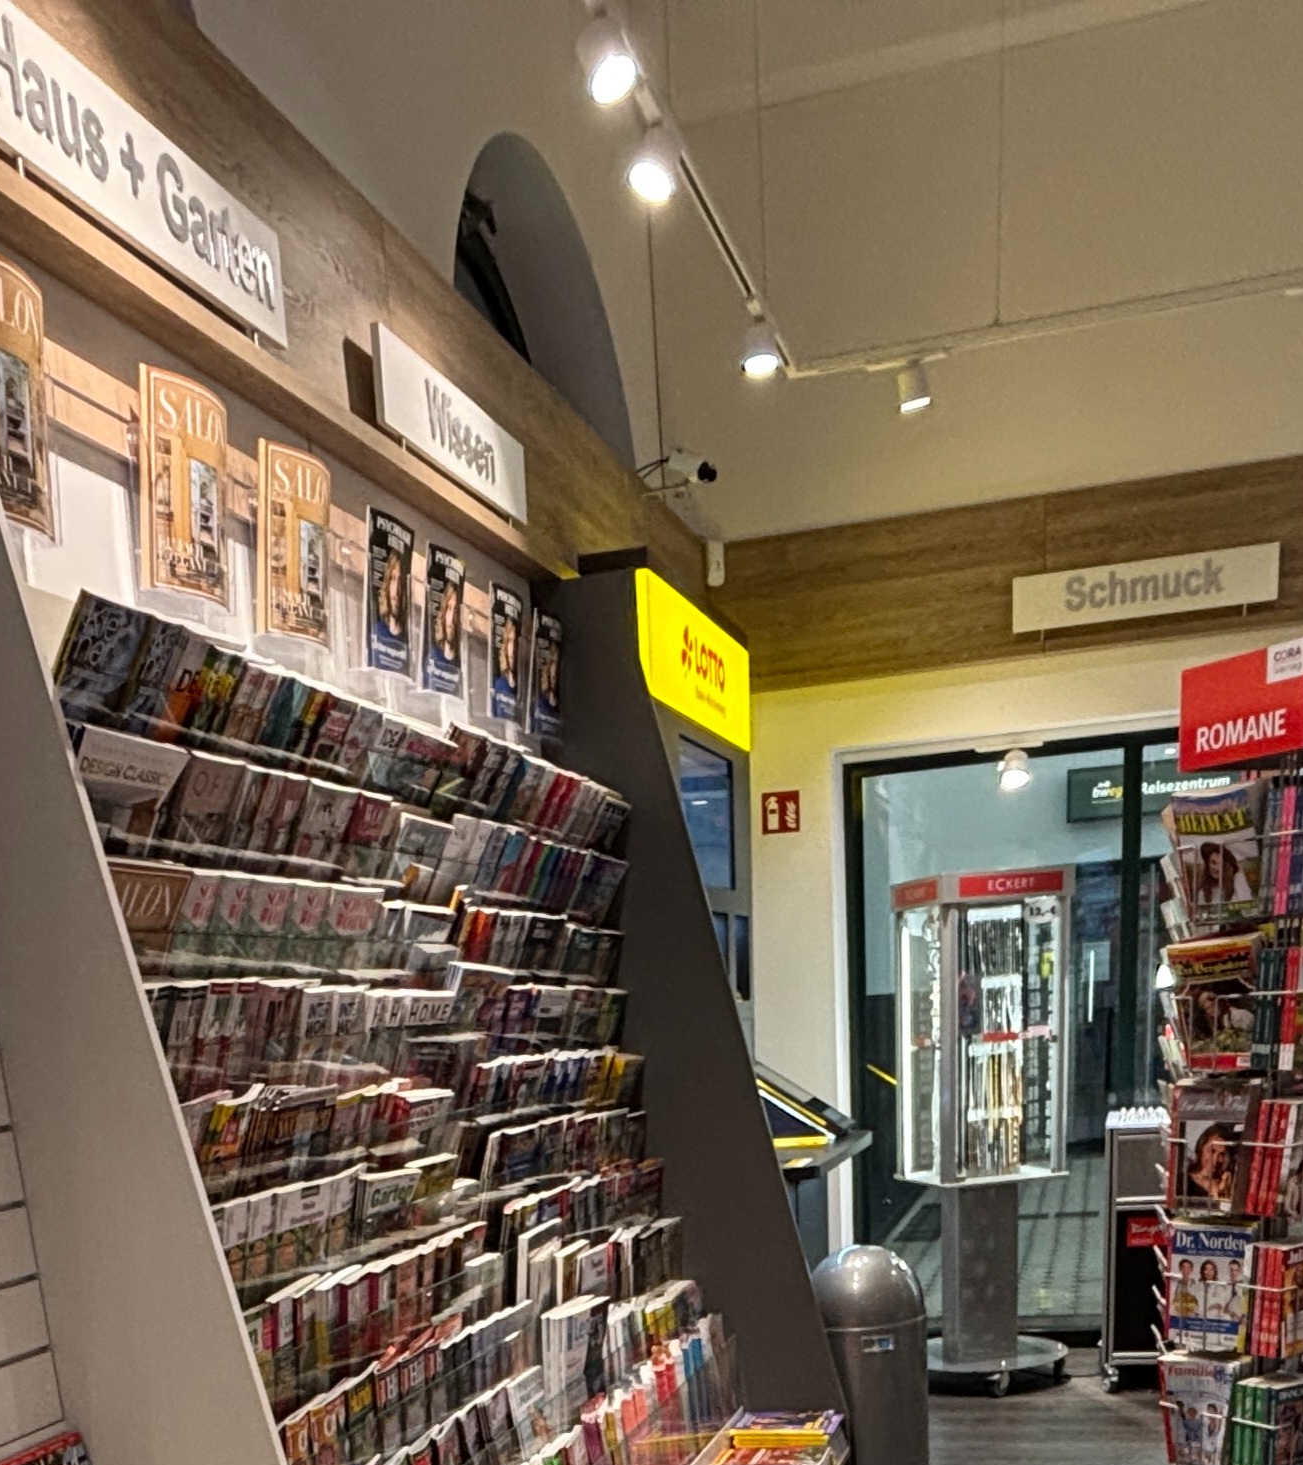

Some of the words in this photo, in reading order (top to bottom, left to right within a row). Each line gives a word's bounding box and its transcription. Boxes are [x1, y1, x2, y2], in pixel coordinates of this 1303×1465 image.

[155, 151, 277, 313] Garten
[423, 377, 496, 487] Wissen
[1064, 556, 1224, 613] Schmuck
[694, 636, 726, 694] LOTTO
[1274, 646, 1302, 663] CORA
[1196, 708, 1287, 754] ROMANE
[987, 877, 1034, 891] ECKERT
[408, 1003, 451, 1025] HOME
[1175, 1231, 1197, 1251] Dr.
[1200, 1231, 1248, 1252] Norden
